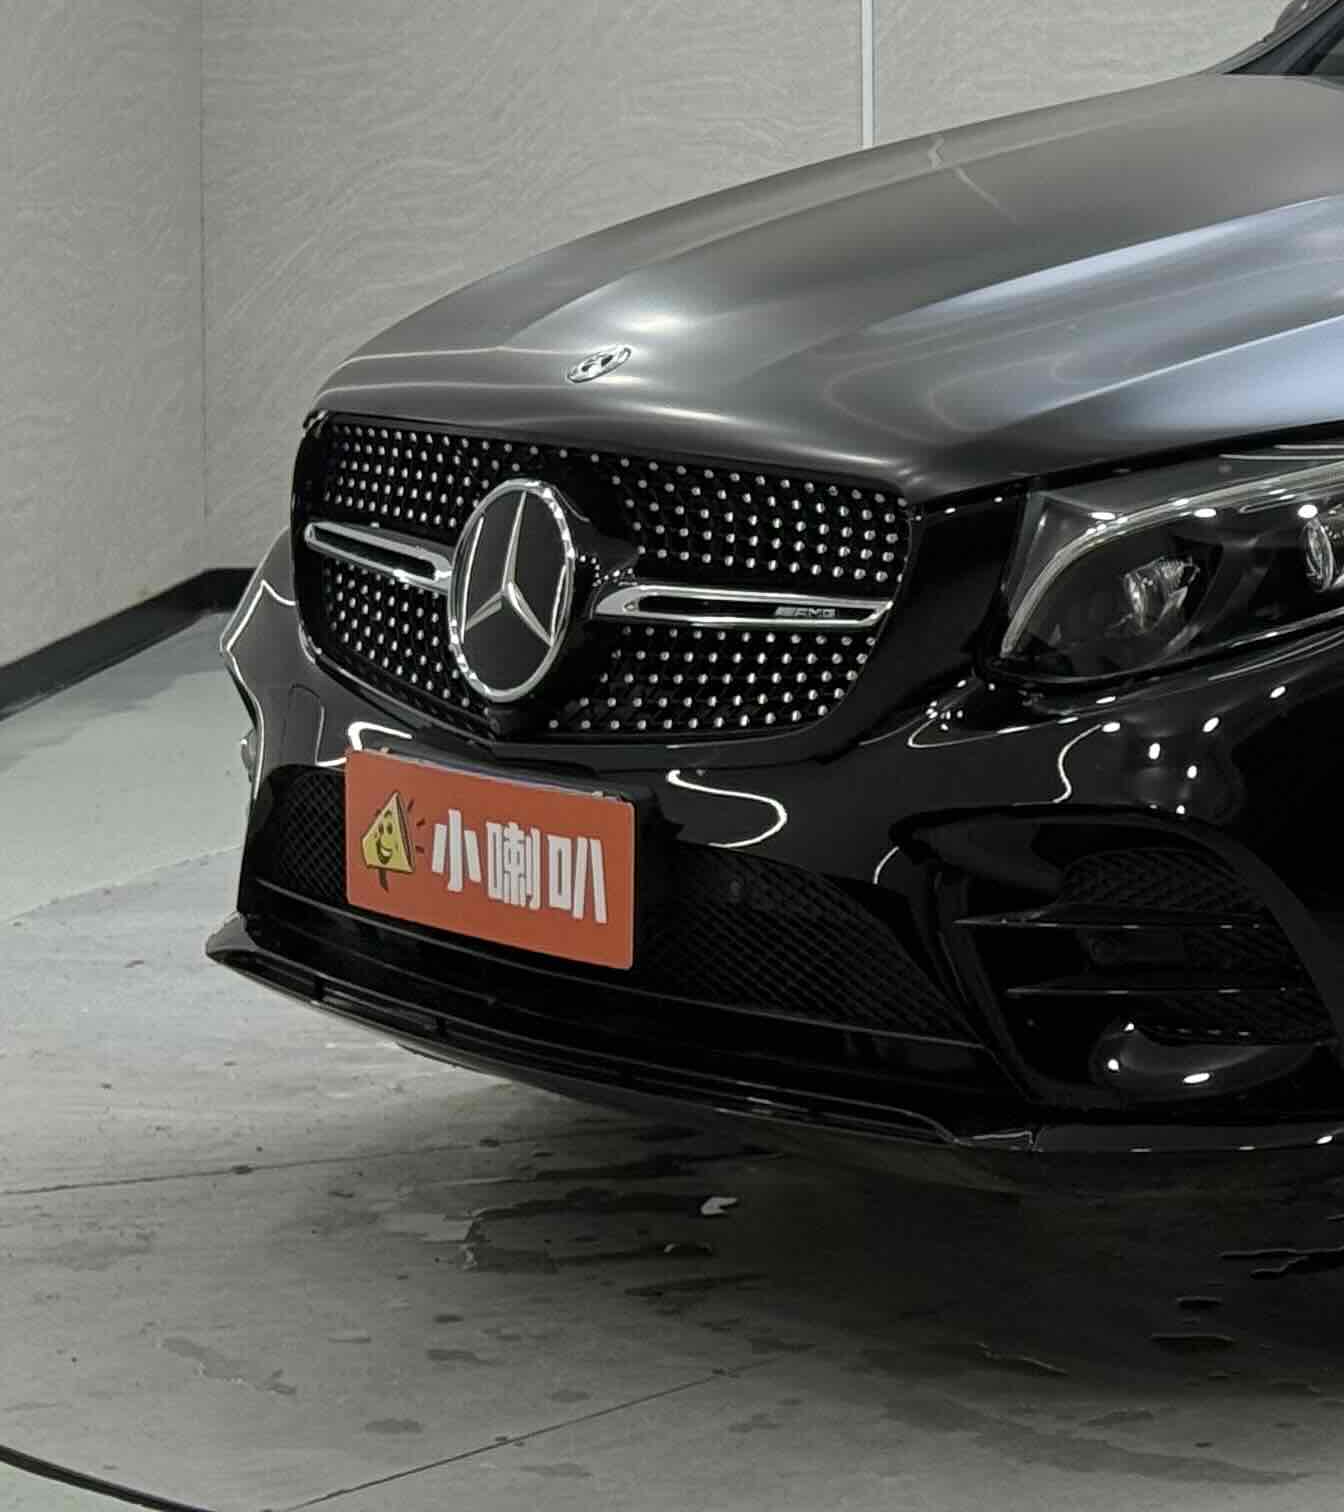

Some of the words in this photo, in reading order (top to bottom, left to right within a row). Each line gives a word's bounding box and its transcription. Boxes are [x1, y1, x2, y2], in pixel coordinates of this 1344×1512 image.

[794, 607, 836, 617] AMG
[431, 808, 608, 925] 小喇叭
